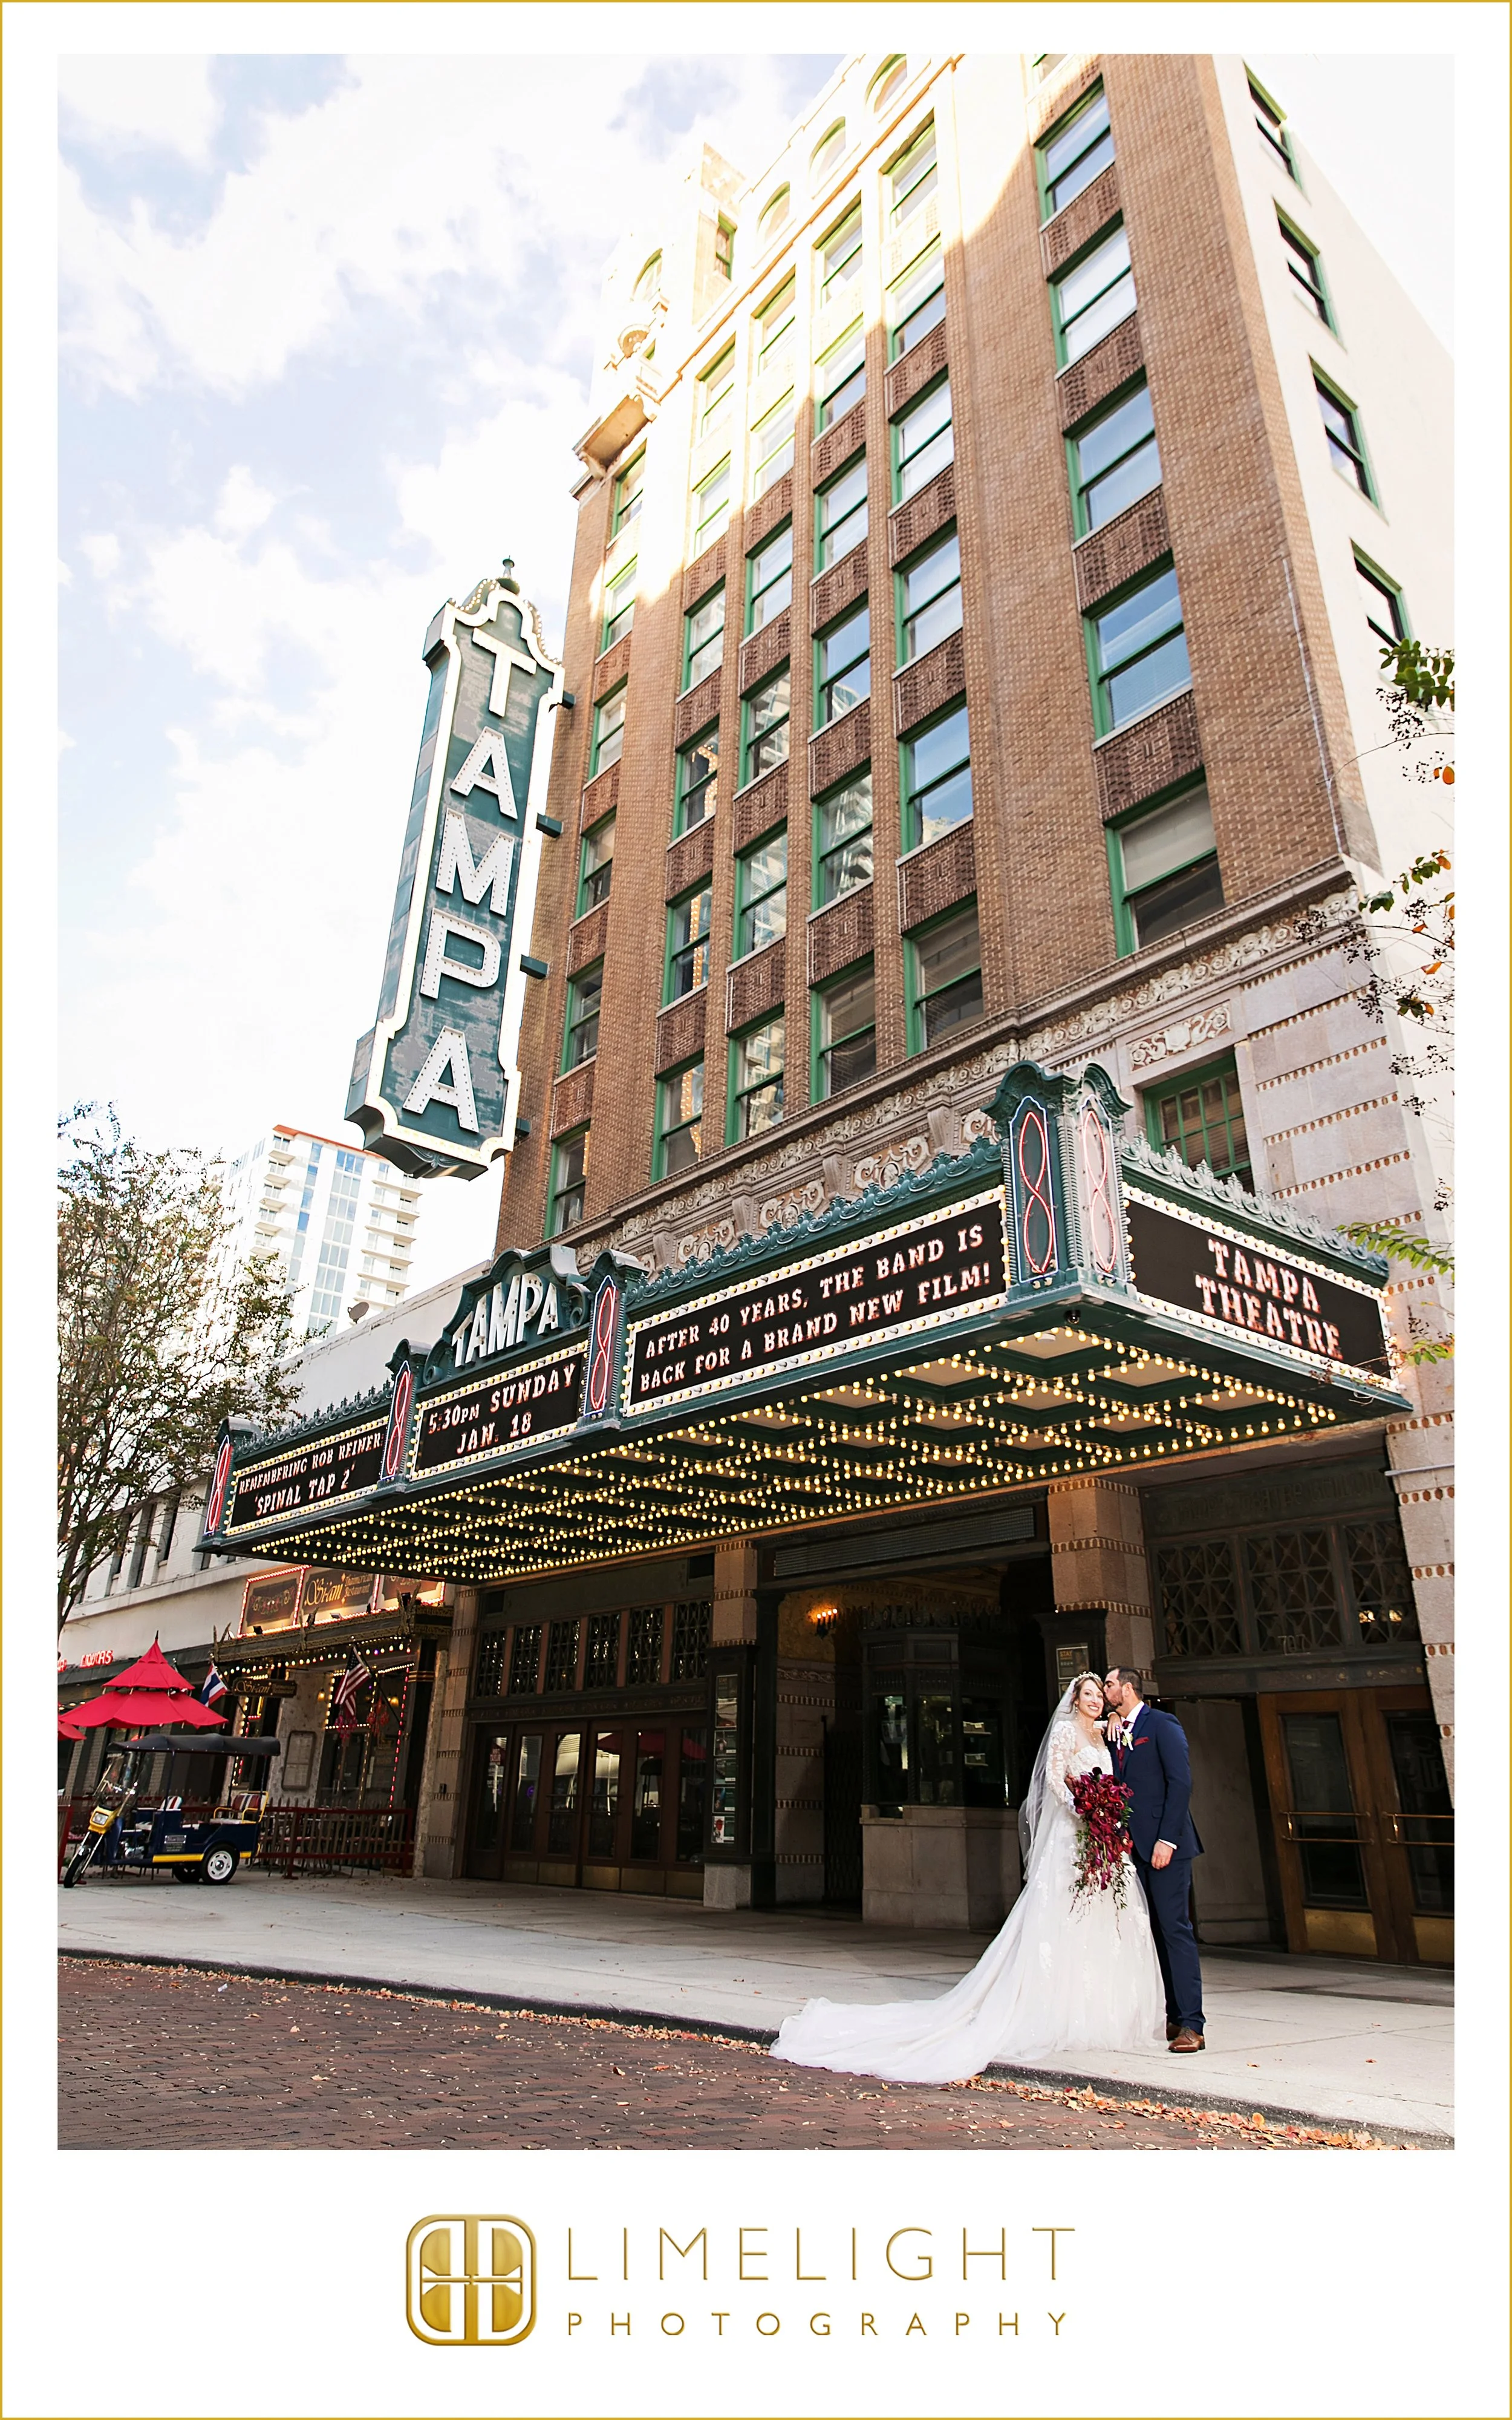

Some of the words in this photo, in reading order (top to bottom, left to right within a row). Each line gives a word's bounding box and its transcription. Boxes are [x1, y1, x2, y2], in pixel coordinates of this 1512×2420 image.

[402, 627, 537, 1133] TAMPA
[645, 1324, 700, 1359] AFTER
[709, 1313, 729, 1336] 40
[740, 1288, 809, 1326] YEARS,
[820, 1265, 864, 1299] THE
[876, 1238, 944, 1280] BAND
[958, 1223, 983, 1252] IS
[1208, 1238, 1321, 1314] TAMPA
[451, 1273, 561, 1368] TAMPA
[640, 1361, 686, 1392] BACK
[695, 1346, 730, 1375] FOR
[740, 1338, 753, 1360] A
[764, 1311, 838, 1353] BRAND
[849, 1289, 904, 1327] NEW
[917, 1261, 990, 1305] FILM!
[1194, 1274, 1343, 1361] THEATRE
[490, 1363, 576, 1412] SUNDAY
[239, 1457, 307, 1494] REMEMBERING
[311, 1449, 334, 1470] ROB
[457, 1422, 499, 1454] JAN.
[509, 1411, 532, 1438] 18
[308, 1473, 336, 1500] TAP
